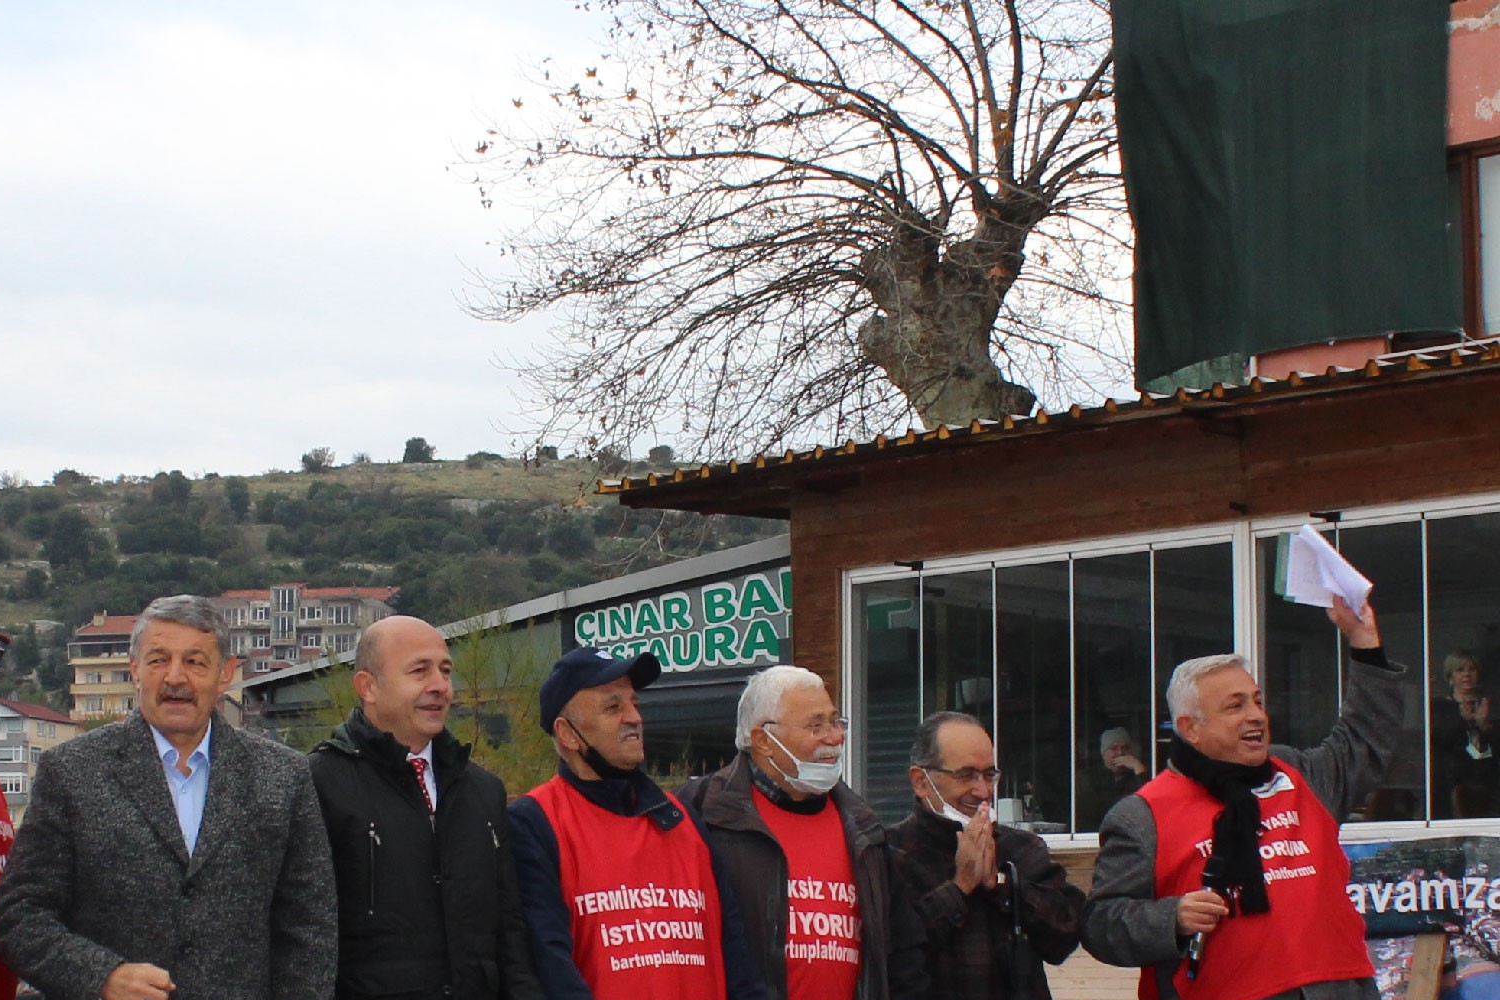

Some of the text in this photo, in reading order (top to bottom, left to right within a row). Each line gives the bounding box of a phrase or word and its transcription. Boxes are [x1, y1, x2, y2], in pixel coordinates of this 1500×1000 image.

[575, 591, 694, 648] ÇINAR
[787, 876, 825, 900] KSİZ
[1264, 865, 1317, 885] platformu
[574, 882, 669, 916] TERMİKSİZ
[601, 918, 705, 947] İSTİYORUM
[610, 949, 706, 971] bartınplatformu
